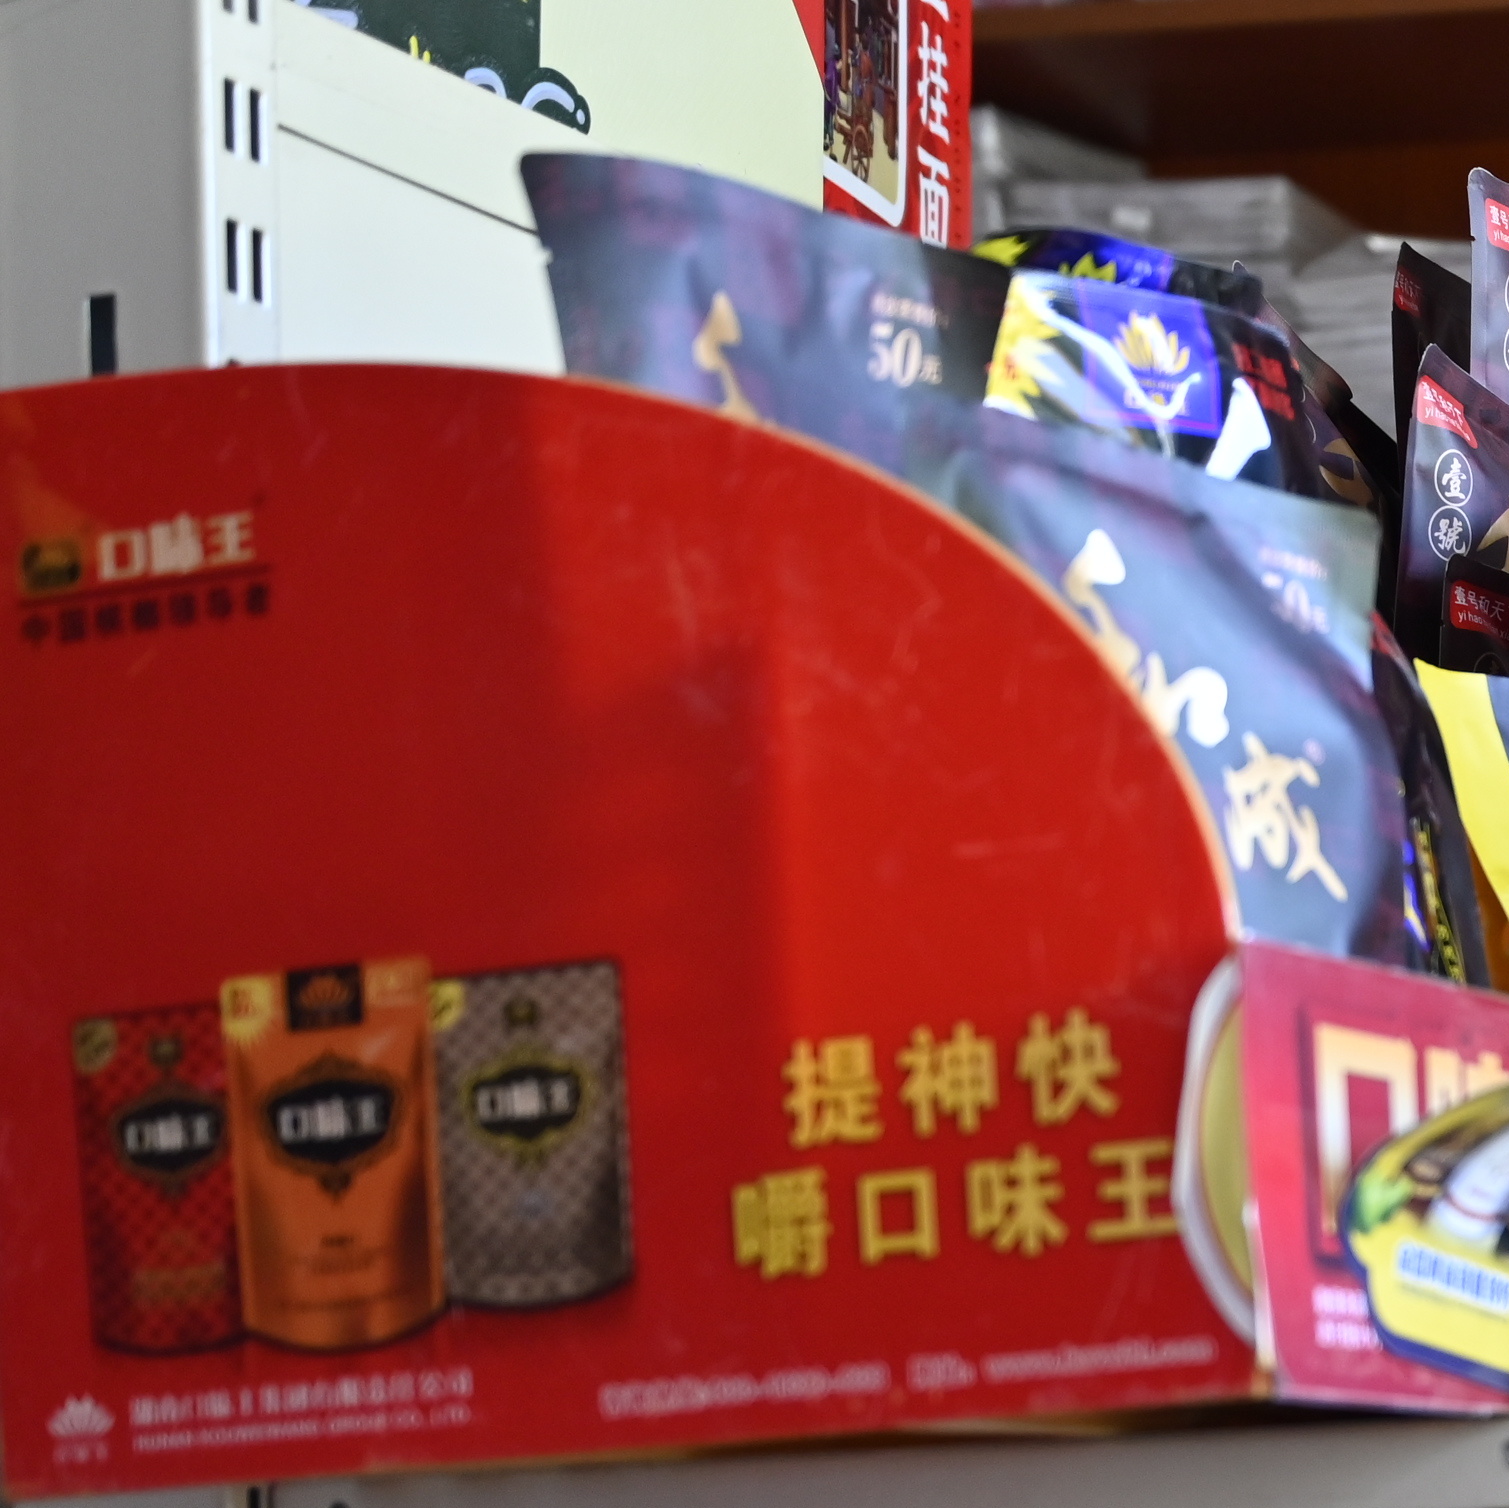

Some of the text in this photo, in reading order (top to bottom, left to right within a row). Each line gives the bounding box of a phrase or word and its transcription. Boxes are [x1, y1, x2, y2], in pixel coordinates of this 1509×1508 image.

[917, 0, 951, 250] 挂面
[783, 1007, 1121, 1149] 提神快
[732, 1138, 1180, 1281] 嚼口味王
